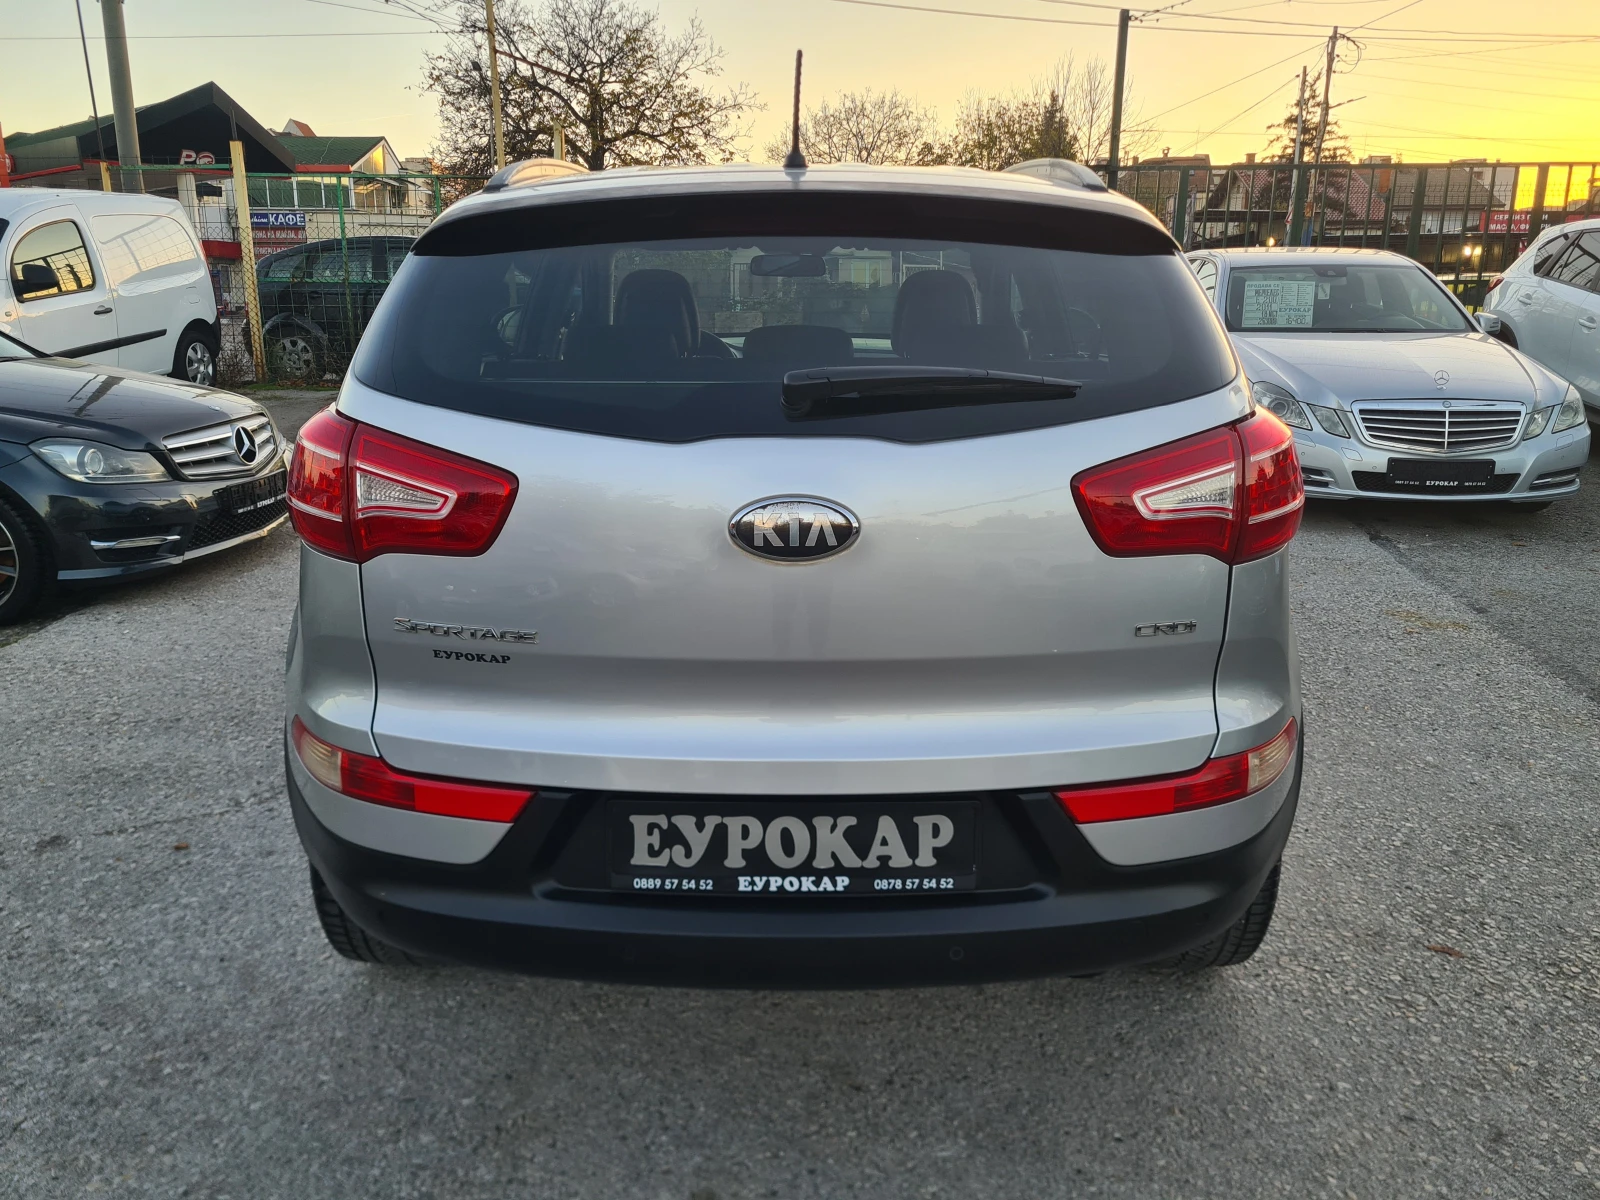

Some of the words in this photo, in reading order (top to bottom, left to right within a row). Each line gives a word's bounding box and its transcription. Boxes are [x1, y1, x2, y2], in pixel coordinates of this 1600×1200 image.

[269, 213, 305, 225] КАФЕ
[752, 513, 838, 547] KIA
[432, 650, 511, 664] ЕУРОКАР
[629, 814, 954, 869] ЕУРОКАР
[633, 878, 662, 889] 0889
[664, 879, 680, 889] 57
[682, 879, 696, 890] 54
[699, 879, 713, 890] 52
[737, 876, 850, 892] ЕУРОКАР
[874, 878, 902, 890] 0878
[905, 878, 920, 889] 57
[922, 878, 938, 889] 54
[939, 878, 954, 889] 52
